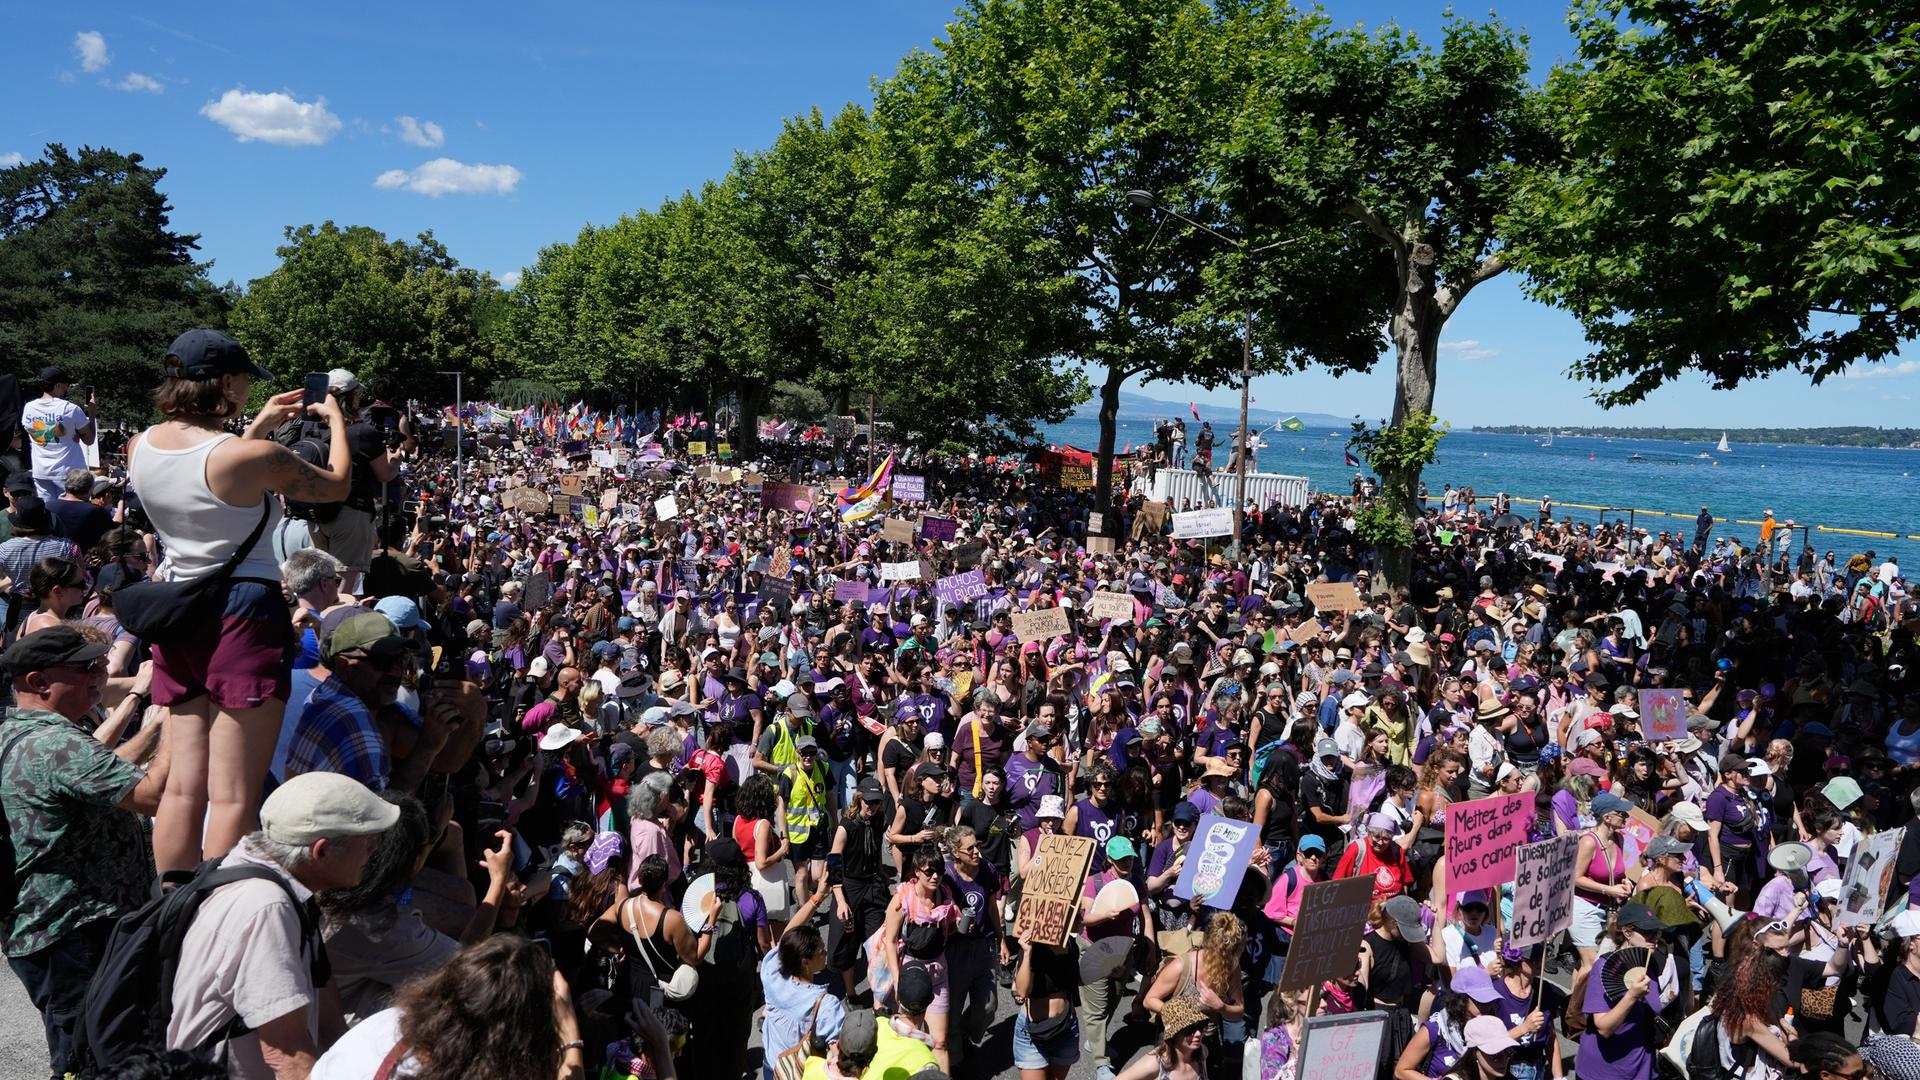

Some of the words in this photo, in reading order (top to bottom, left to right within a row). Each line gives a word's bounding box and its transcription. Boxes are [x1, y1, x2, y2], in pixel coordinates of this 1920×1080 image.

[25, 412, 63, 423] Sevilla
[562, 475, 579, 486] G7
[937, 570, 979, 591] FACHOS
[940, 592, 953, 603] AU
[1454, 806, 1498, 833] Mettez
[1502, 797, 1522, 817] des
[1039, 835, 1087, 857] CALMEZ
[1448, 833, 1482, 863] fleurs
[1487, 820, 1513, 840] dans
[1046, 857, 1071, 875] VOUS
[1452, 857, 1477, 879] vos
[1518, 863, 1531, 887] de
[1025, 870, 1076, 897] MONSIEUR
[1530, 885, 1542, 910] de
[1546, 873, 1571, 912] justice
[1306, 886, 1321, 910] LE
[1322, 883, 1340, 905] G7
[1036, 898, 1045, 919] VA
[1047, 901, 1068, 924] BIEN
[1017, 919, 1031, 935] SE
[1030, 921, 1063, 942] PASSER
[1513, 916, 1526, 940] et
[1530, 911, 1545, 937] de
[1292, 959, 1312, 981] ET
[1330, 1024, 1357, 1053] G7
[1336, 1062, 1373, 1080] CHIER
